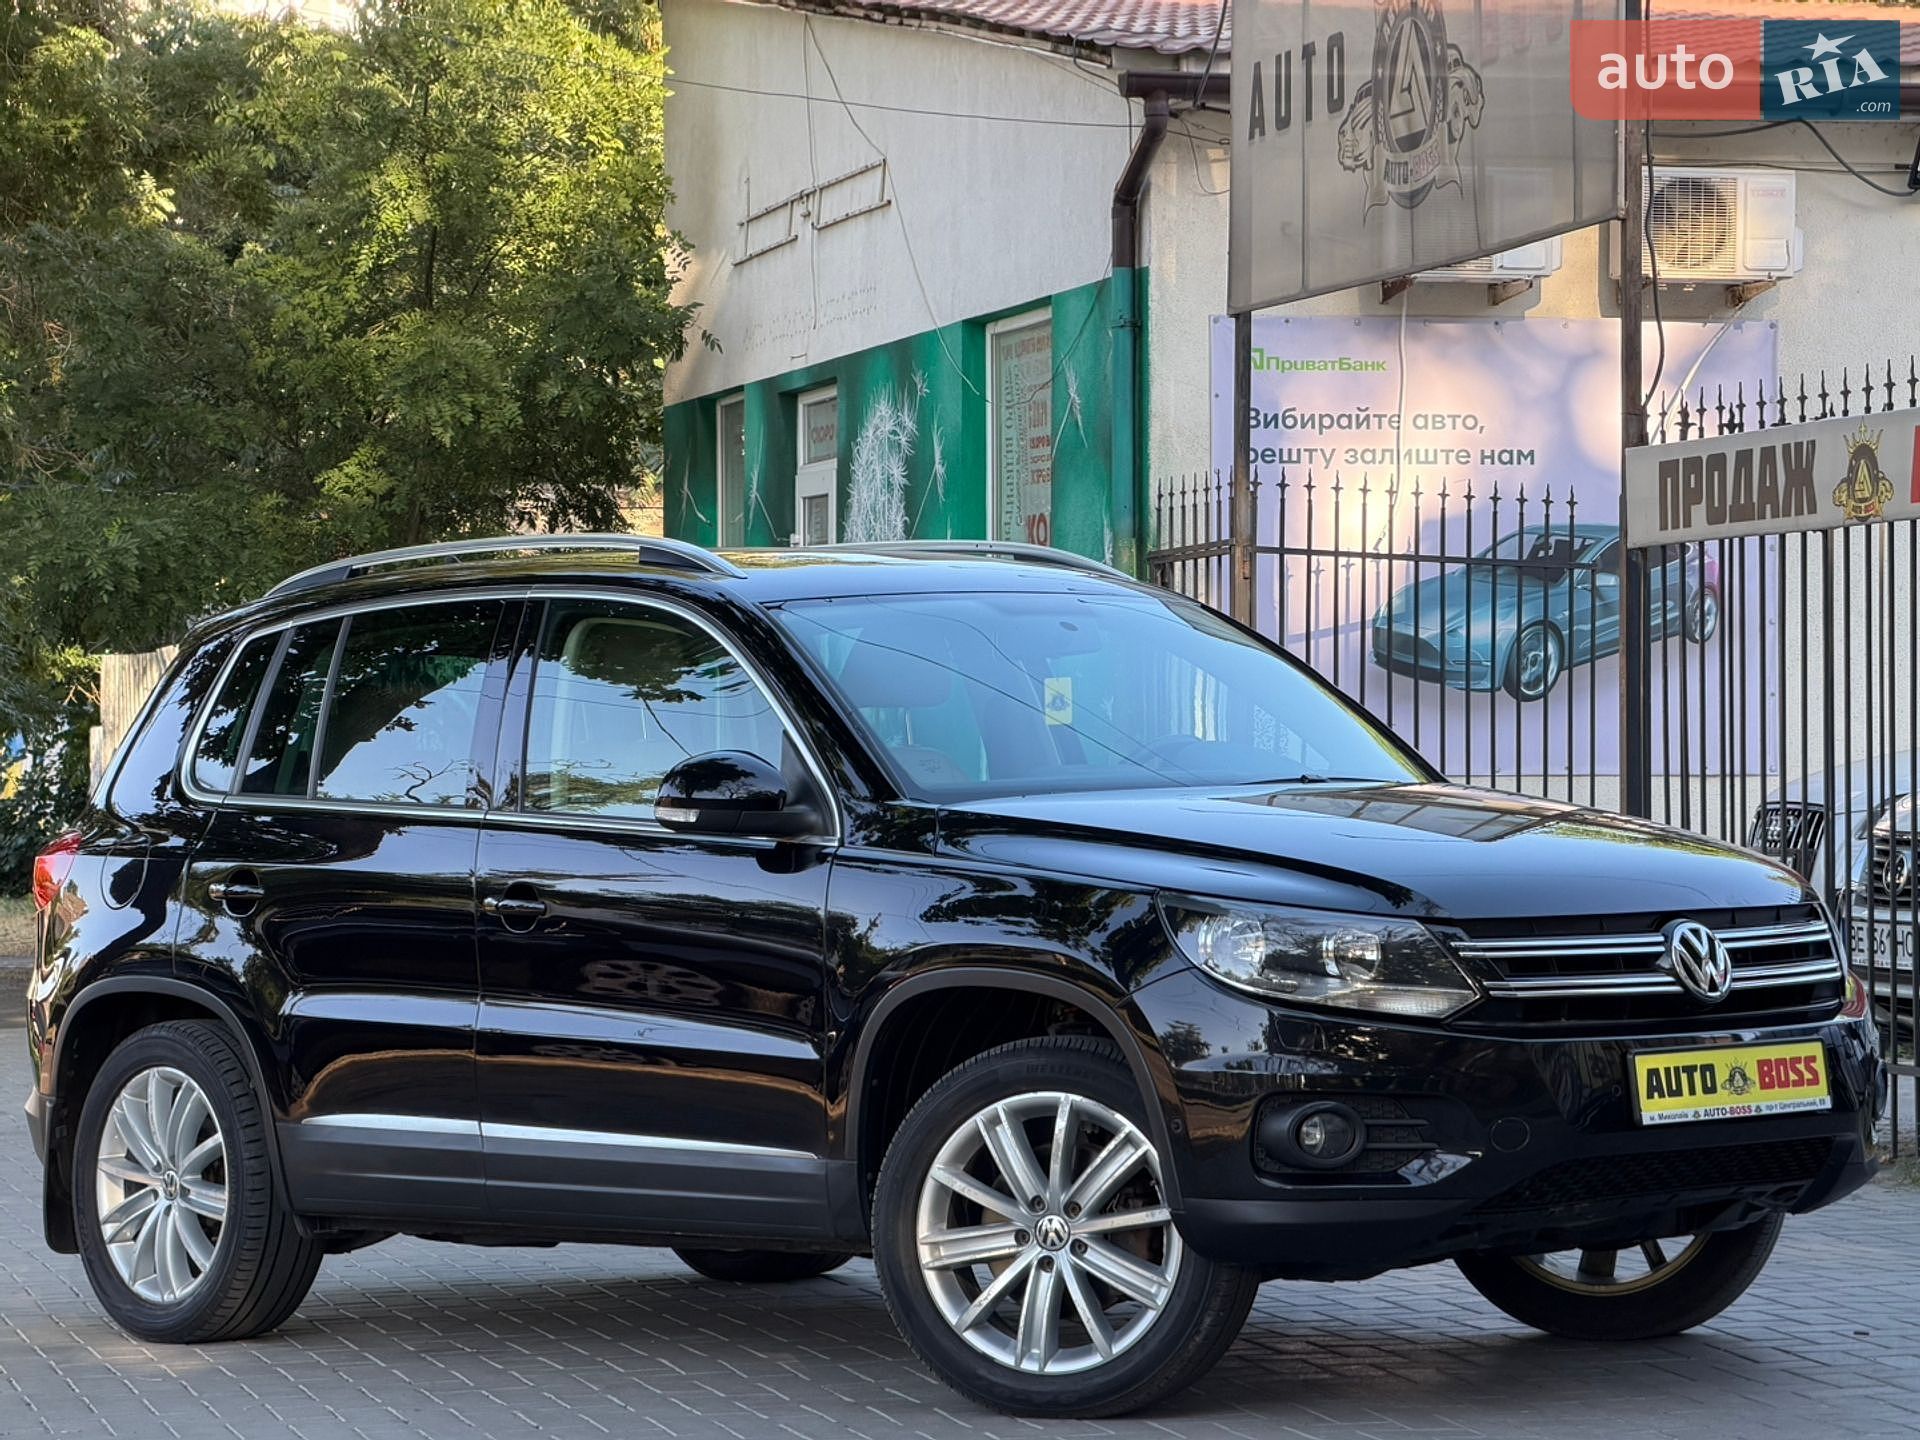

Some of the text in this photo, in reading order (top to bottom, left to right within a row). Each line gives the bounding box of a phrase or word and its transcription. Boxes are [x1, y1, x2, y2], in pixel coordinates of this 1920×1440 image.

[1248, 31, 1345, 141] AUTO
[1266, 356, 1387, 373] ПриватБанк
[1250, 406, 1486, 435] Вибирайте авто,
[1344, 446, 1471, 465] залиште
[1480, 448, 1536, 466] нам
[1658, 439, 1817, 532] ПРОДАЖ
[1646, 1055, 1820, 1100] AUTO BOSS
[1703, 1105, 1753, 1117] AUTO-BOSS
